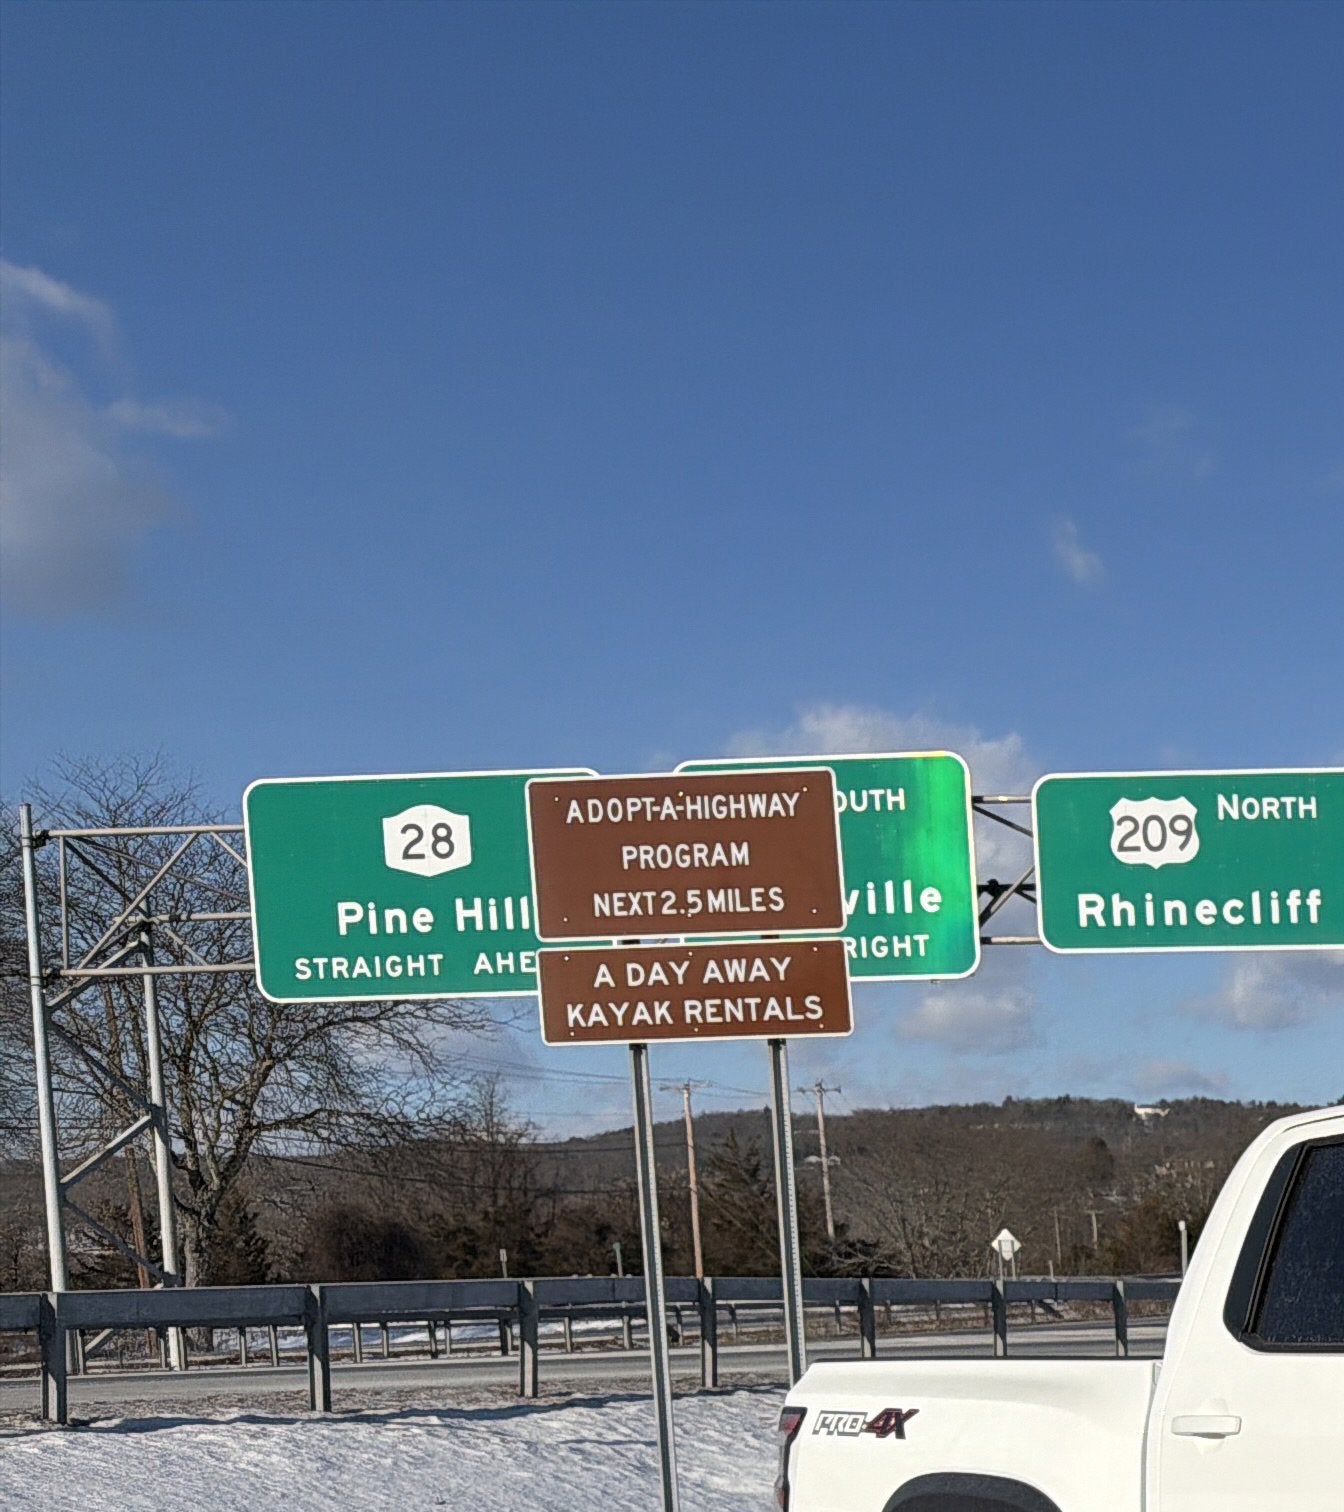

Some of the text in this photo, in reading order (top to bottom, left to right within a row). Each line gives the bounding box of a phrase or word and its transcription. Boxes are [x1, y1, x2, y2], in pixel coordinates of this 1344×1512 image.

[565, 792, 800, 824] ADOPT-A-HIGHWAY
[835, 787, 906, 813] OUTH
[1216, 793, 1318, 820] NORTH
[400, 822, 455, 860] 28
[1116, 814, 1193, 853] 209
[621, 841, 750, 870] PROGRAM
[593, 886, 785, 917] NEXT 2.5 MILES
[844, 879, 943, 915] ville
[1077, 888, 1322, 928] Rhinecliff
[337, 896, 530, 936] Pine Hill
[845, 934, 930, 959] RIGHT
[294, 951, 536, 980] STRAIGHT AHE
[593, 956, 792, 988] A DAY AWAY
[566, 995, 824, 1028] KAYAK RENTALS
